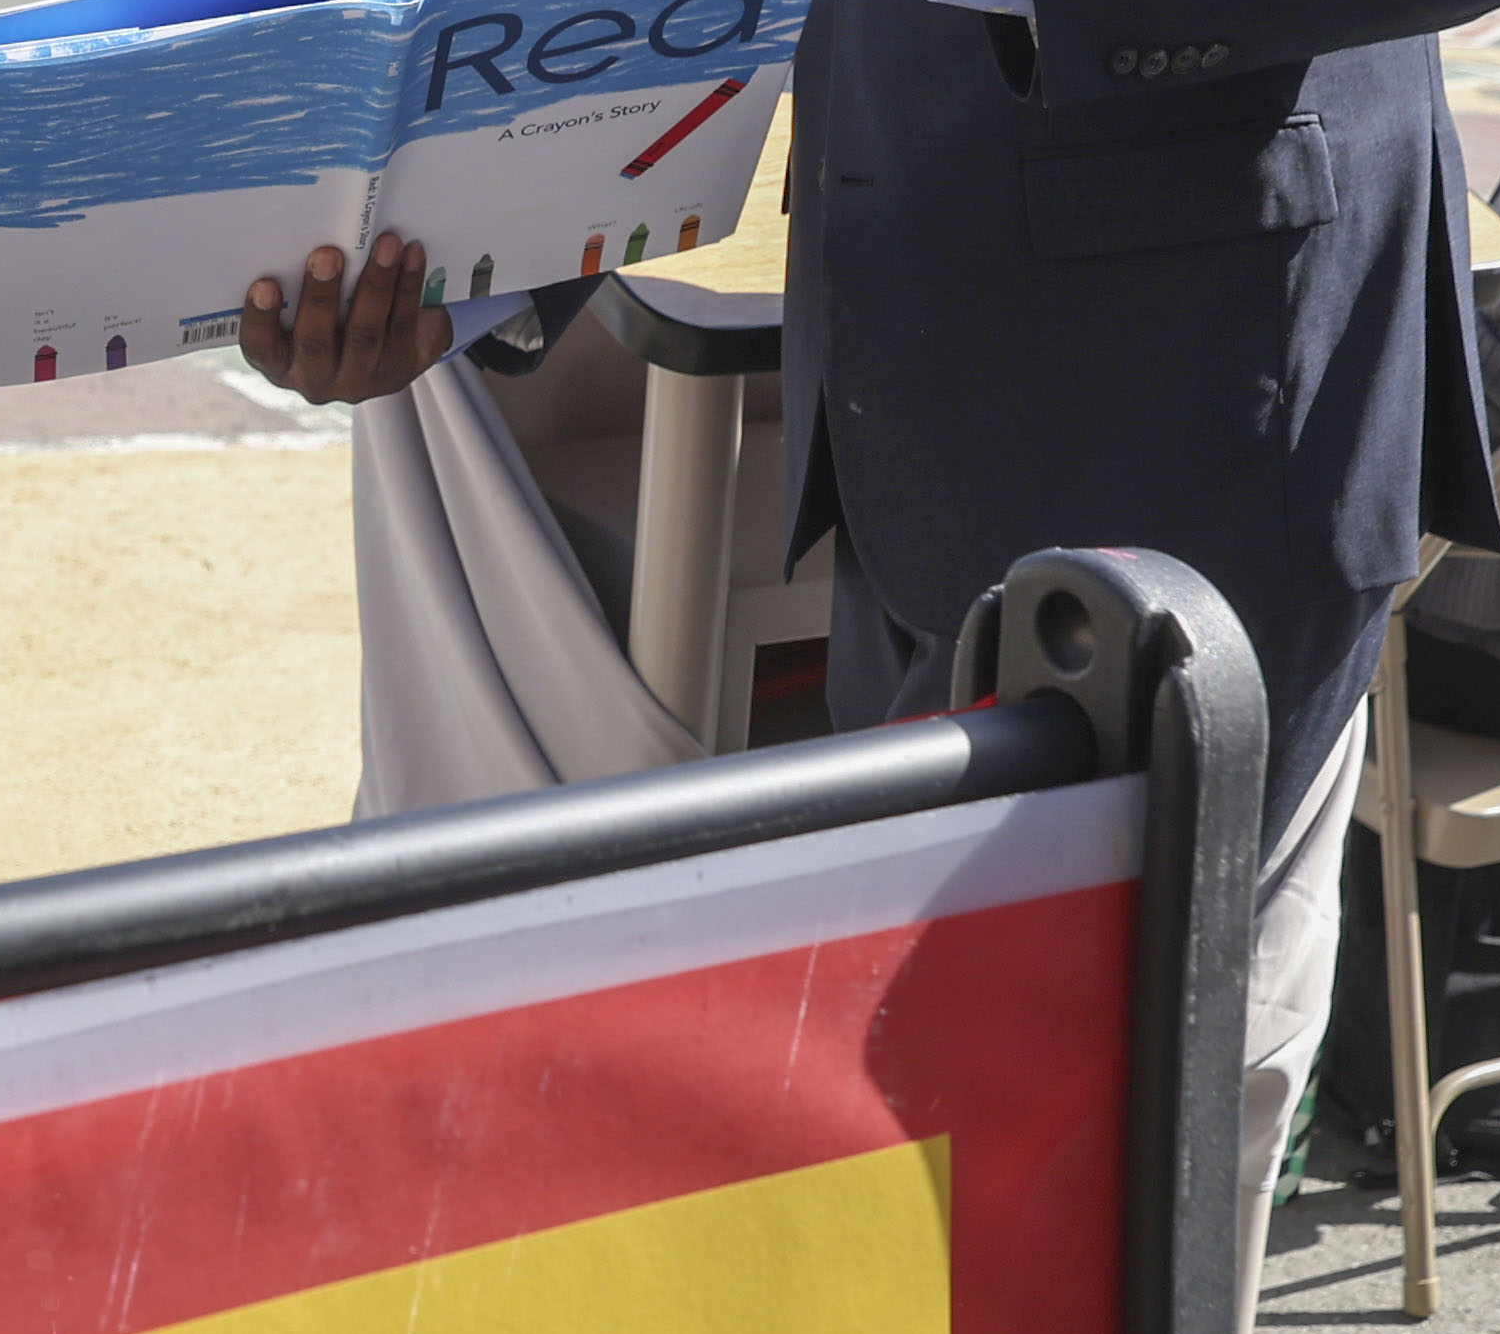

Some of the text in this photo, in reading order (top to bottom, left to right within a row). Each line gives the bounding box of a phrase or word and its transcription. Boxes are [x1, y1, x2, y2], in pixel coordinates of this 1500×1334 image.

[498, 98, 663, 141] A Crayon's Story
